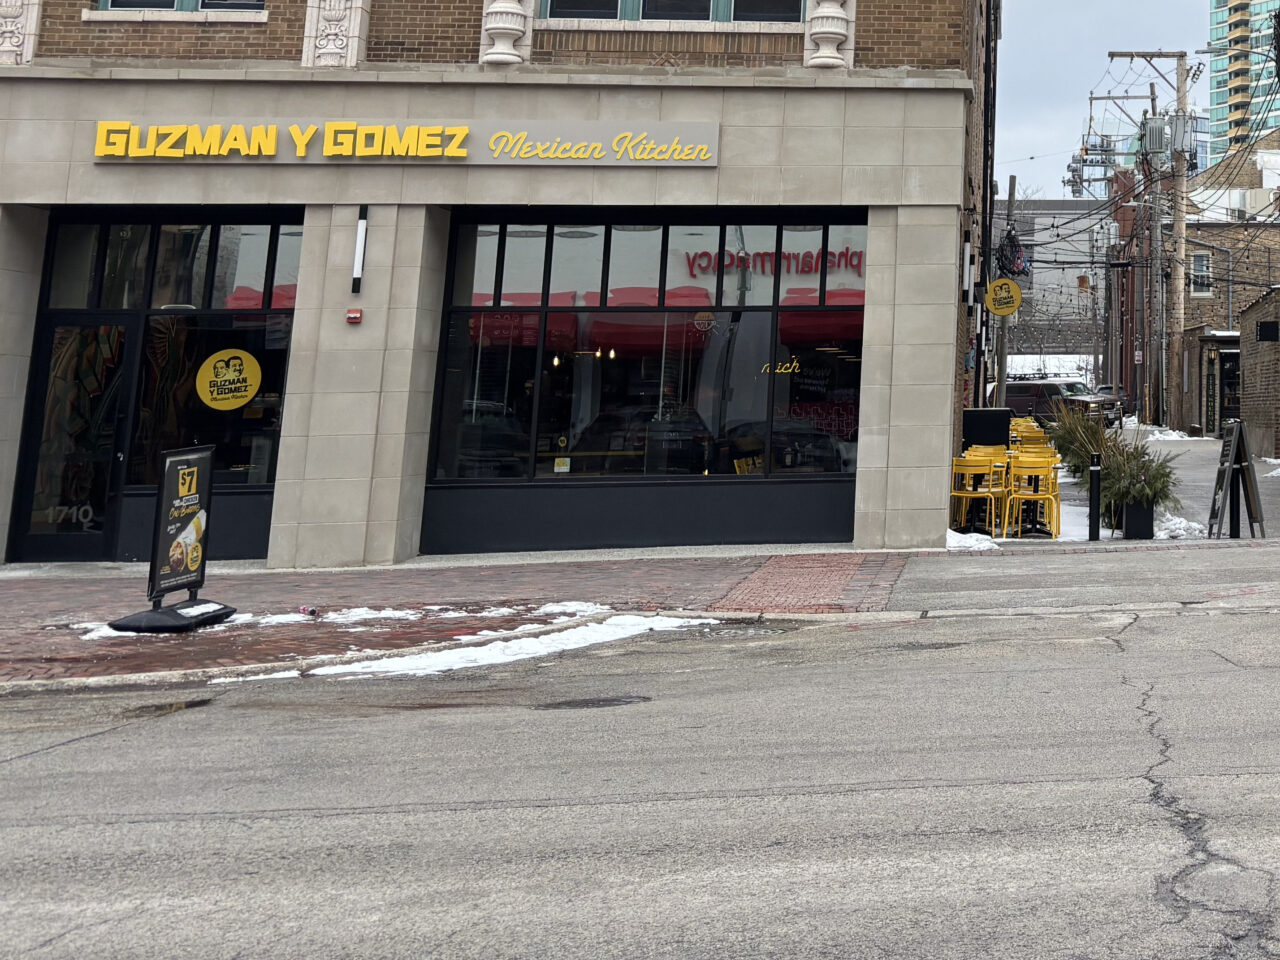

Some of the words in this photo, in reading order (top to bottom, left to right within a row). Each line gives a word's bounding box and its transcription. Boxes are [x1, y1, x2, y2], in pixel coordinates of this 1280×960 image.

[95, 121, 278, 157] GUZMAN
[289, 123, 318, 157] Y
[323, 121, 469, 157] GOMEZ
[489, 131, 606, 159] Mexican
[613, 132, 712, 161] Kitchen
[208, 377, 248, 388] GUZMAN
[209, 389, 215, 397] Y
[216, 385, 249, 395] GOMEZ
[180, 470, 196, 493] $7
[47, 505, 93, 523] 1710
